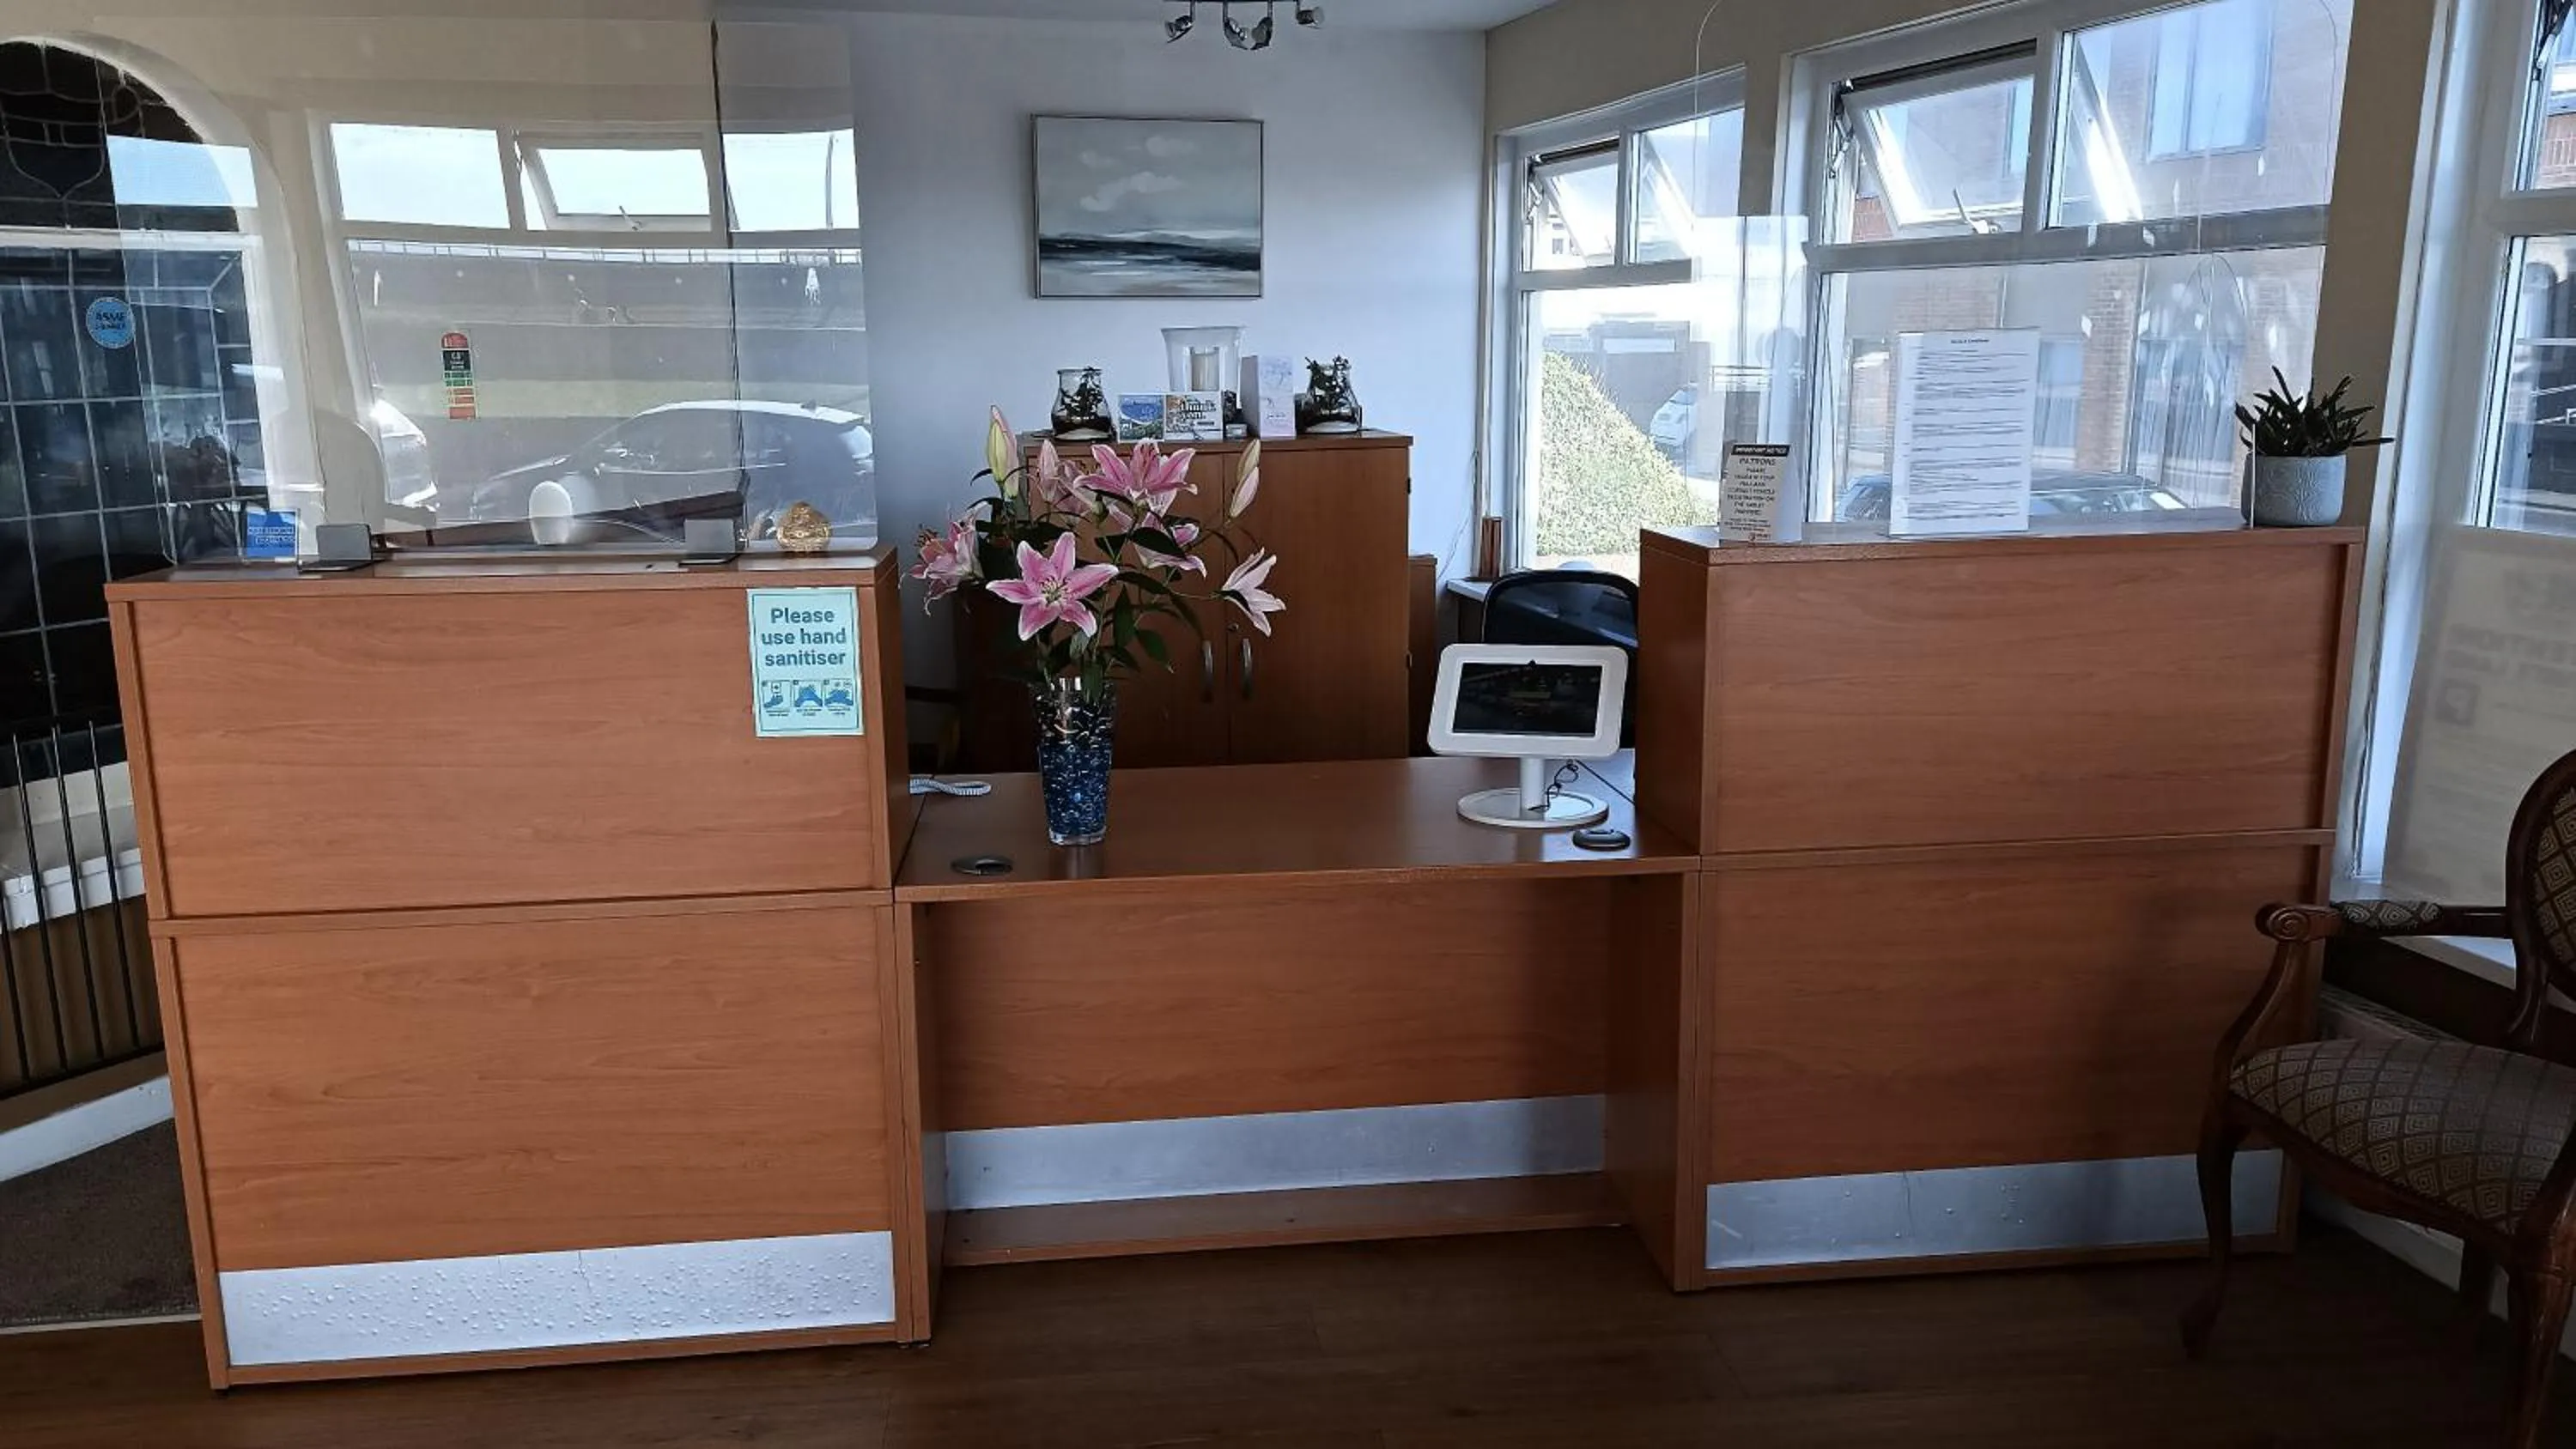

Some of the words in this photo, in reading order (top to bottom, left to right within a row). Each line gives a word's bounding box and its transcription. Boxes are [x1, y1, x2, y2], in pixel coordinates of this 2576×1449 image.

[1739, 458, 1777, 466] PATRONS
[770, 608, 835, 624] Please
[762, 632, 795, 646] use
[800, 627, 847, 645] hand
[765, 650, 846, 667] sanitiser
